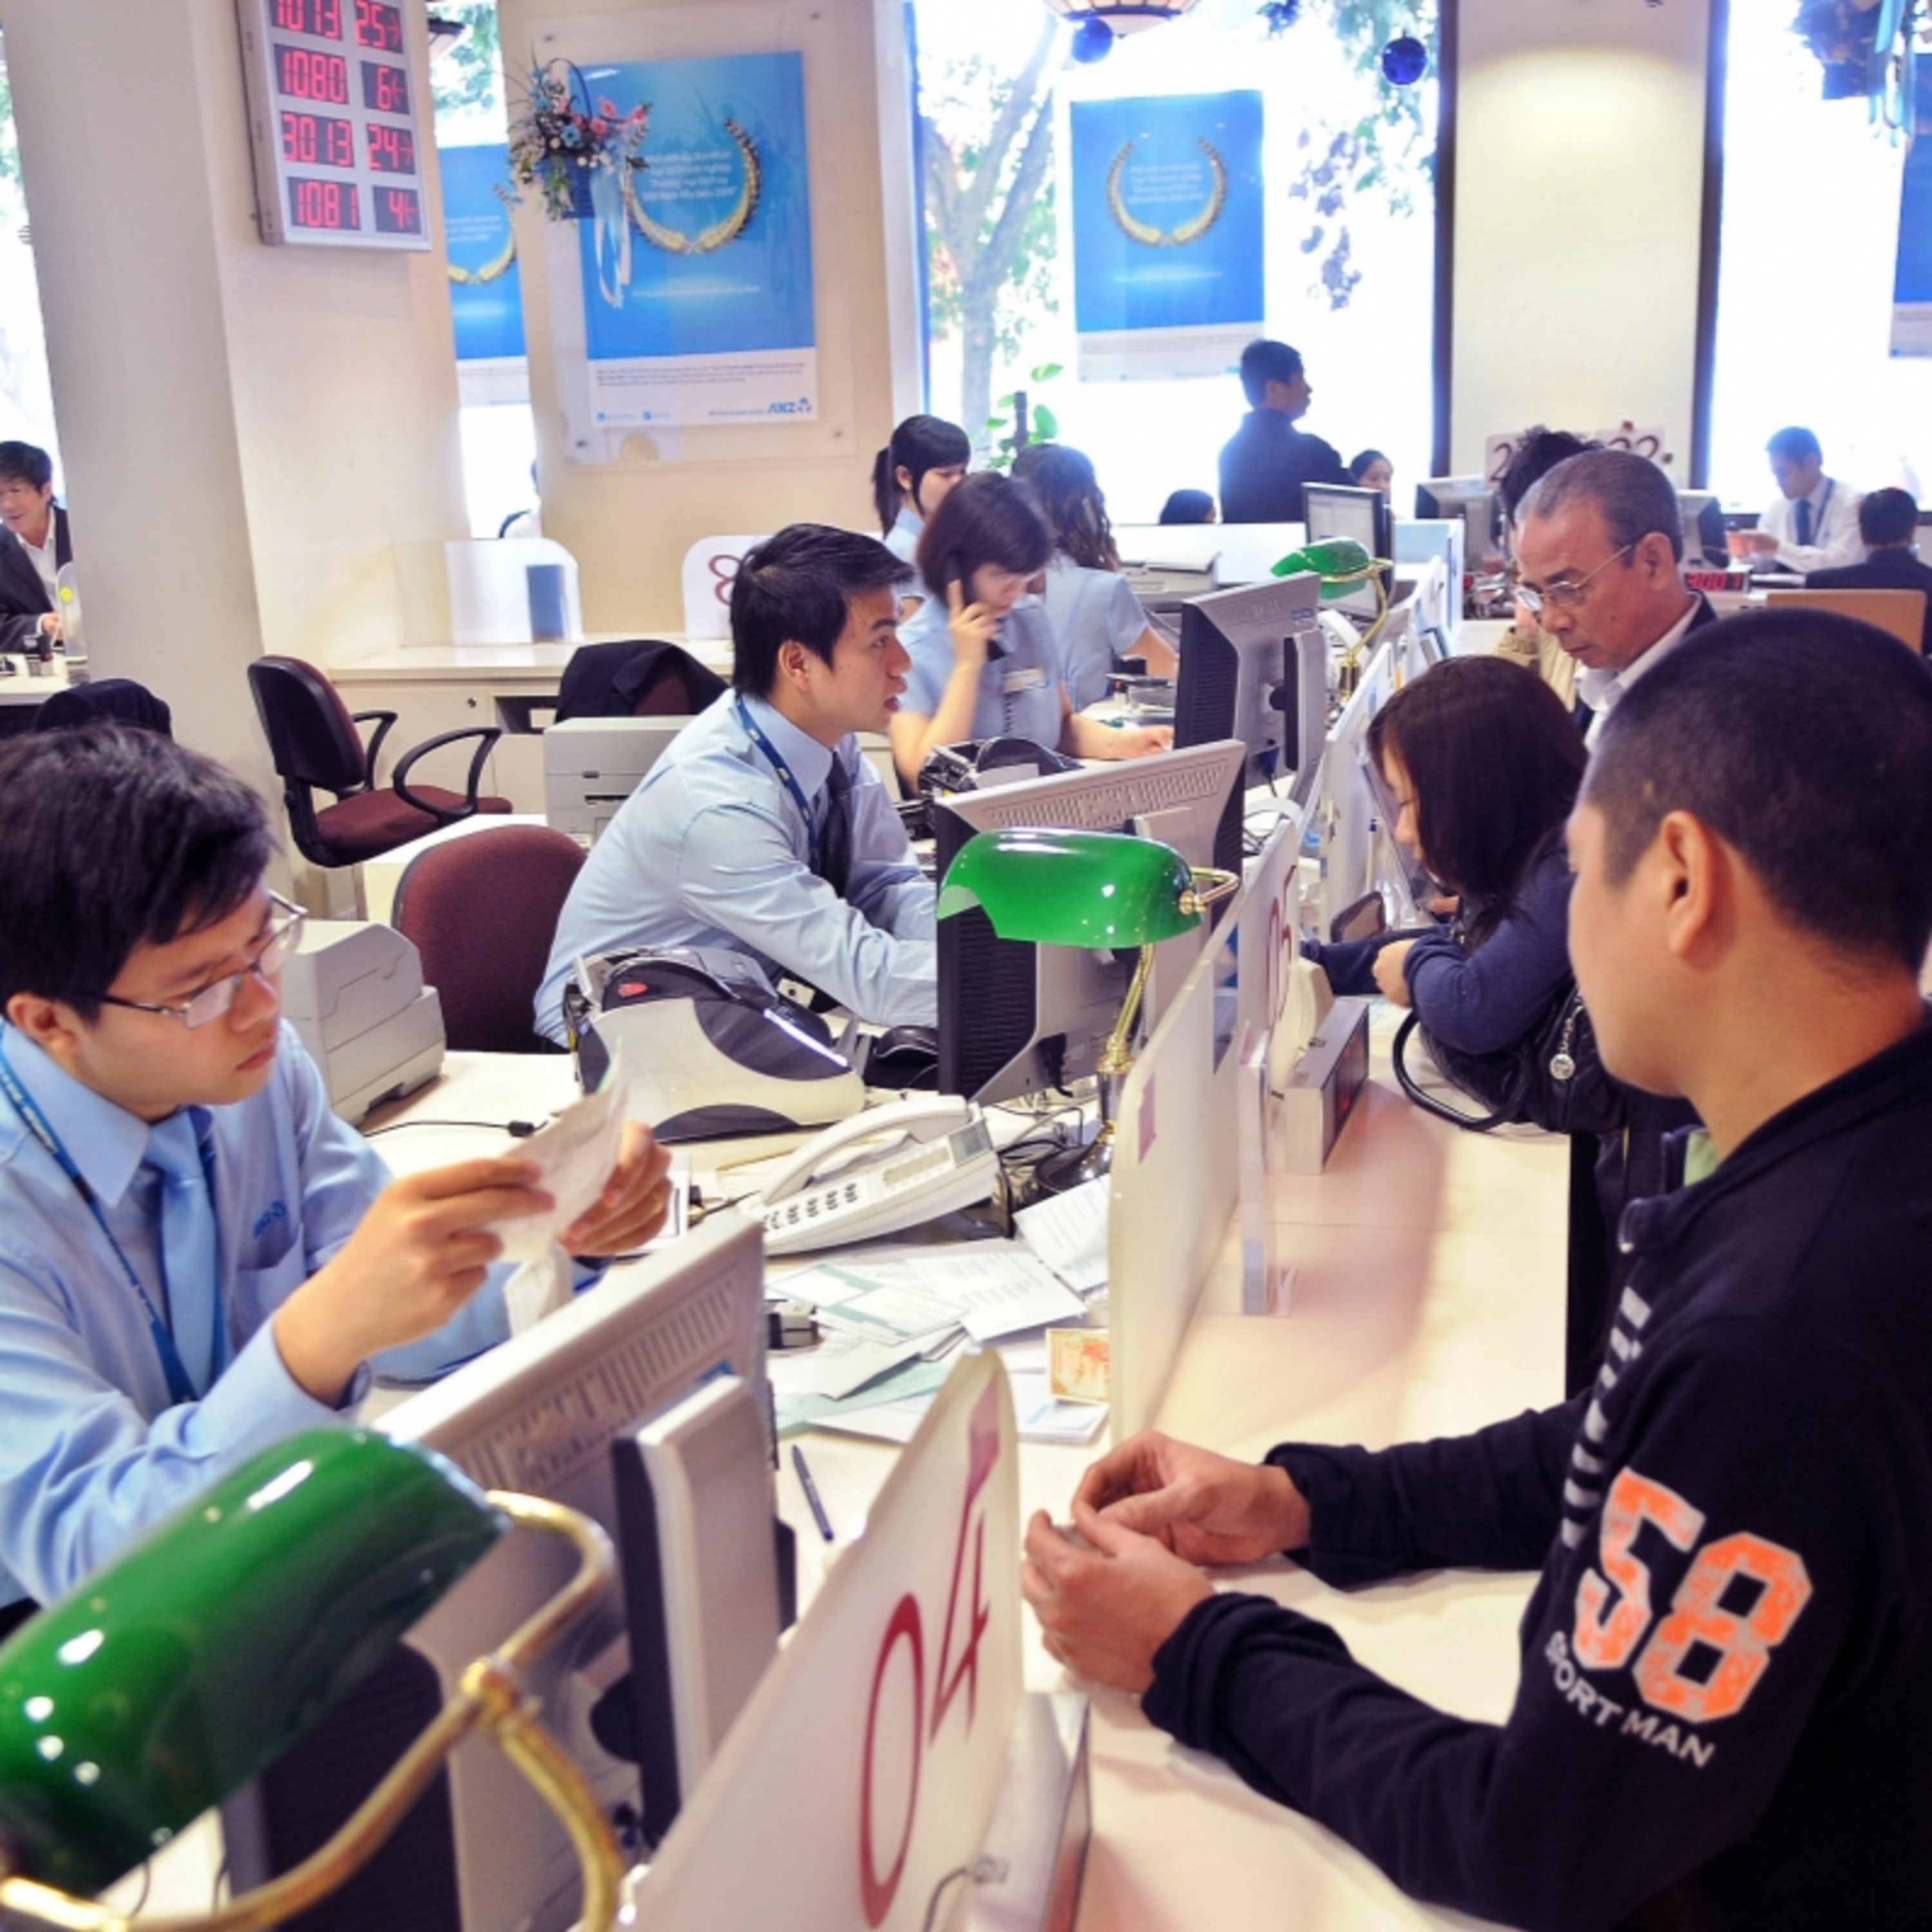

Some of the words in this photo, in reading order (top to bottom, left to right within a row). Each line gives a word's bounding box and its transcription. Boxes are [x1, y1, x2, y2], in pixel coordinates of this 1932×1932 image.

[283, 50, 346, 104] 1080
[282, 113, 352, 166] 3013
[296, 181, 357, 229] 1081
[1572, 1466, 1813, 1724] 58
[858, 1504, 990, 1930] 04
[1621, 1710, 1715, 1768] MAN
